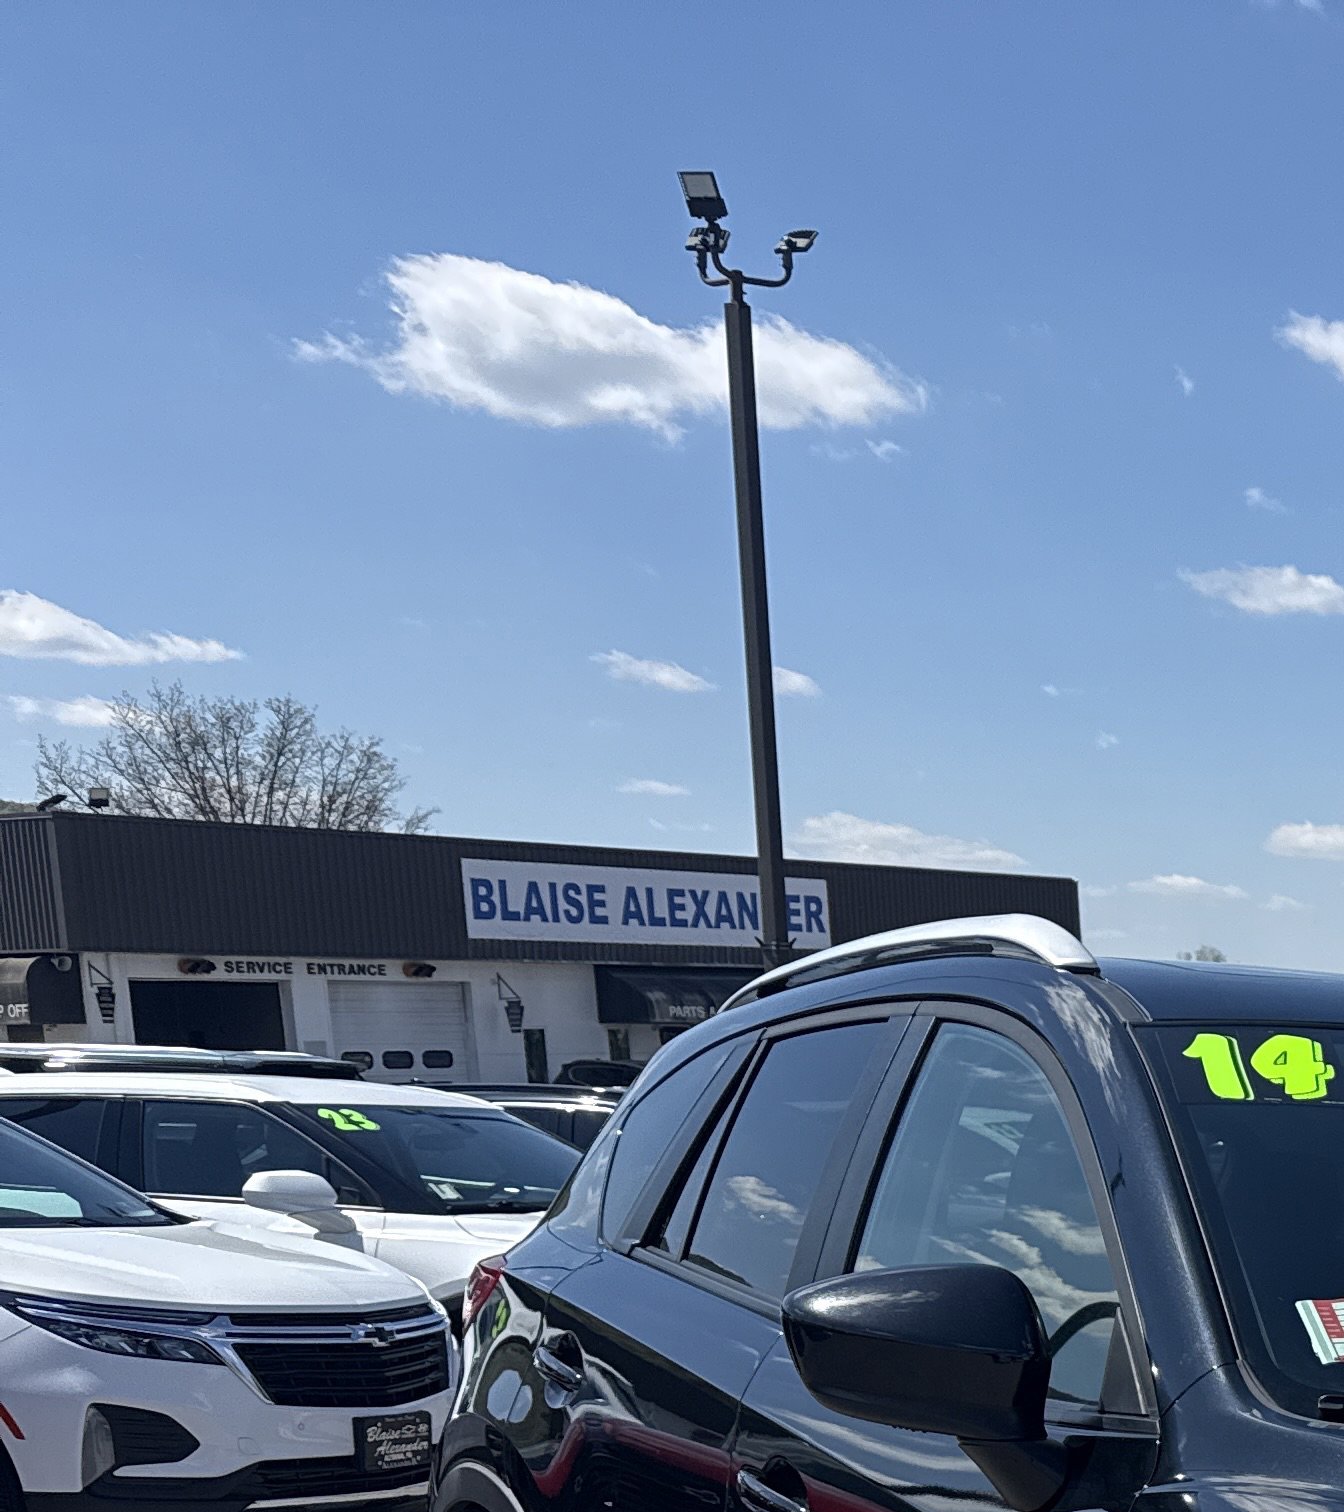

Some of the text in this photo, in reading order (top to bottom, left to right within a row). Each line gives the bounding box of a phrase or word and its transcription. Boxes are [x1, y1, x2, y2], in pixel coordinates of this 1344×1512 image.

[470, 877, 825, 933] BLAISE ALEXANER
[224, 960, 387, 976] SERVICE ENTRANCE
[7, 1003, 29, 1017] OFF
[669, 1005, 707, 1018] PARTS
[1182, 1033, 1335, 1100] 14
[317, 1108, 381, 1131] 23
